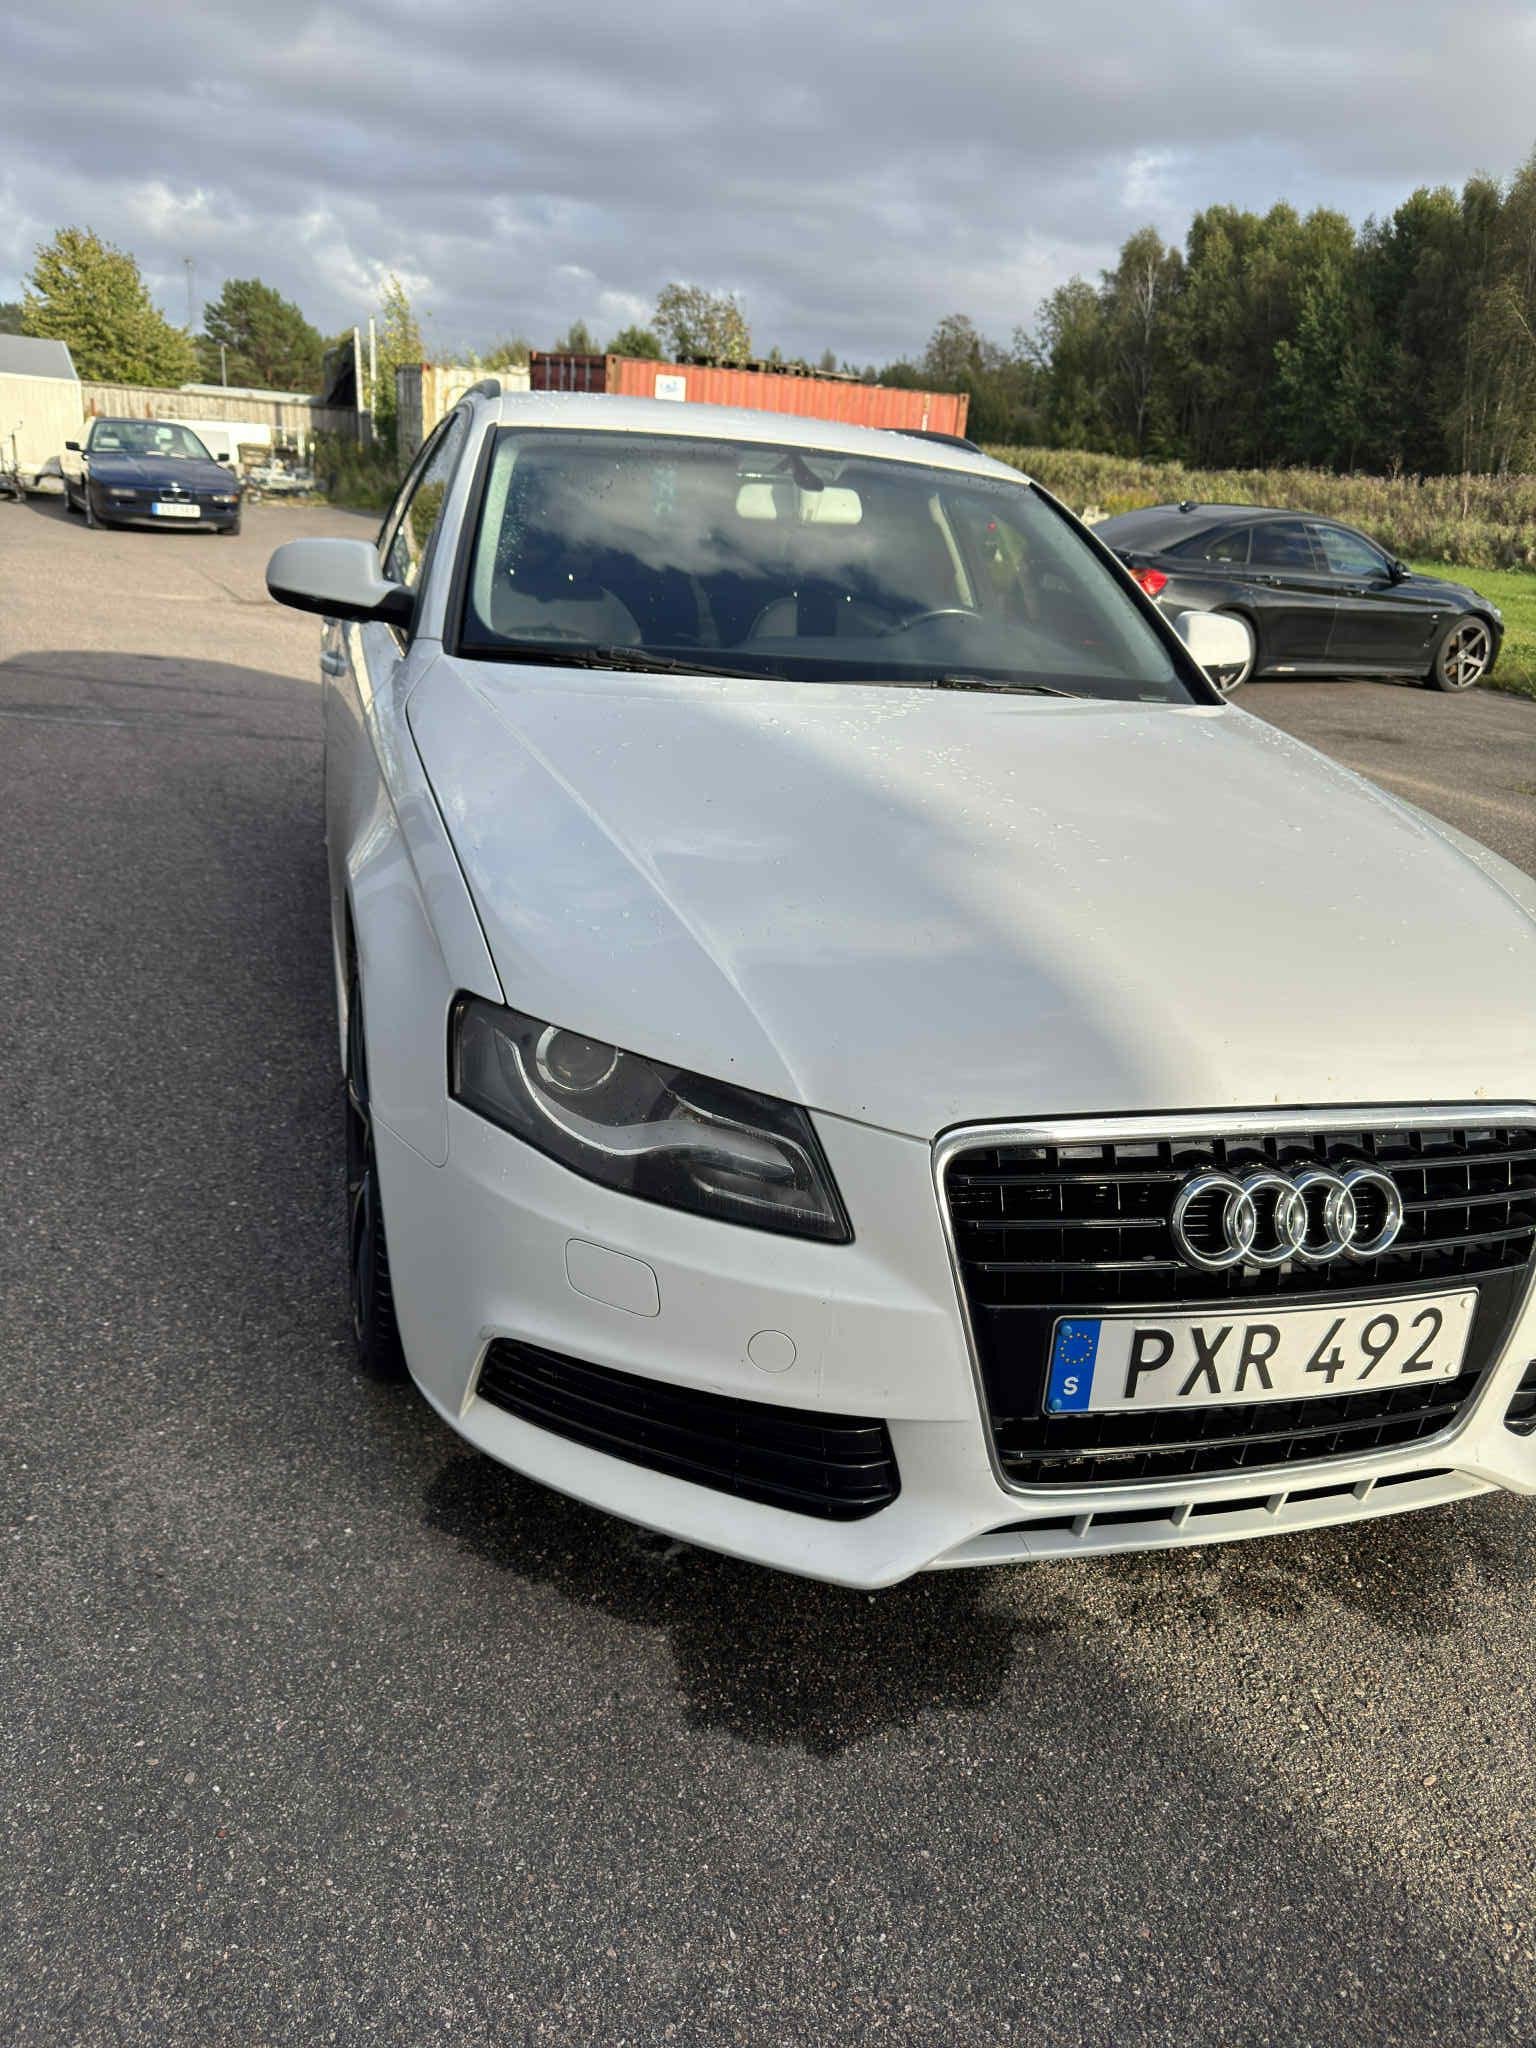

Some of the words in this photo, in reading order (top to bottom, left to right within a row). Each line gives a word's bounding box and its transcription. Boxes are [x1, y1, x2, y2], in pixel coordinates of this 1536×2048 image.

[1123, 1324, 1281, 1399] PXR
[1305, 1307, 1443, 1384] 492
[1063, 1376, 1079, 1396] S
